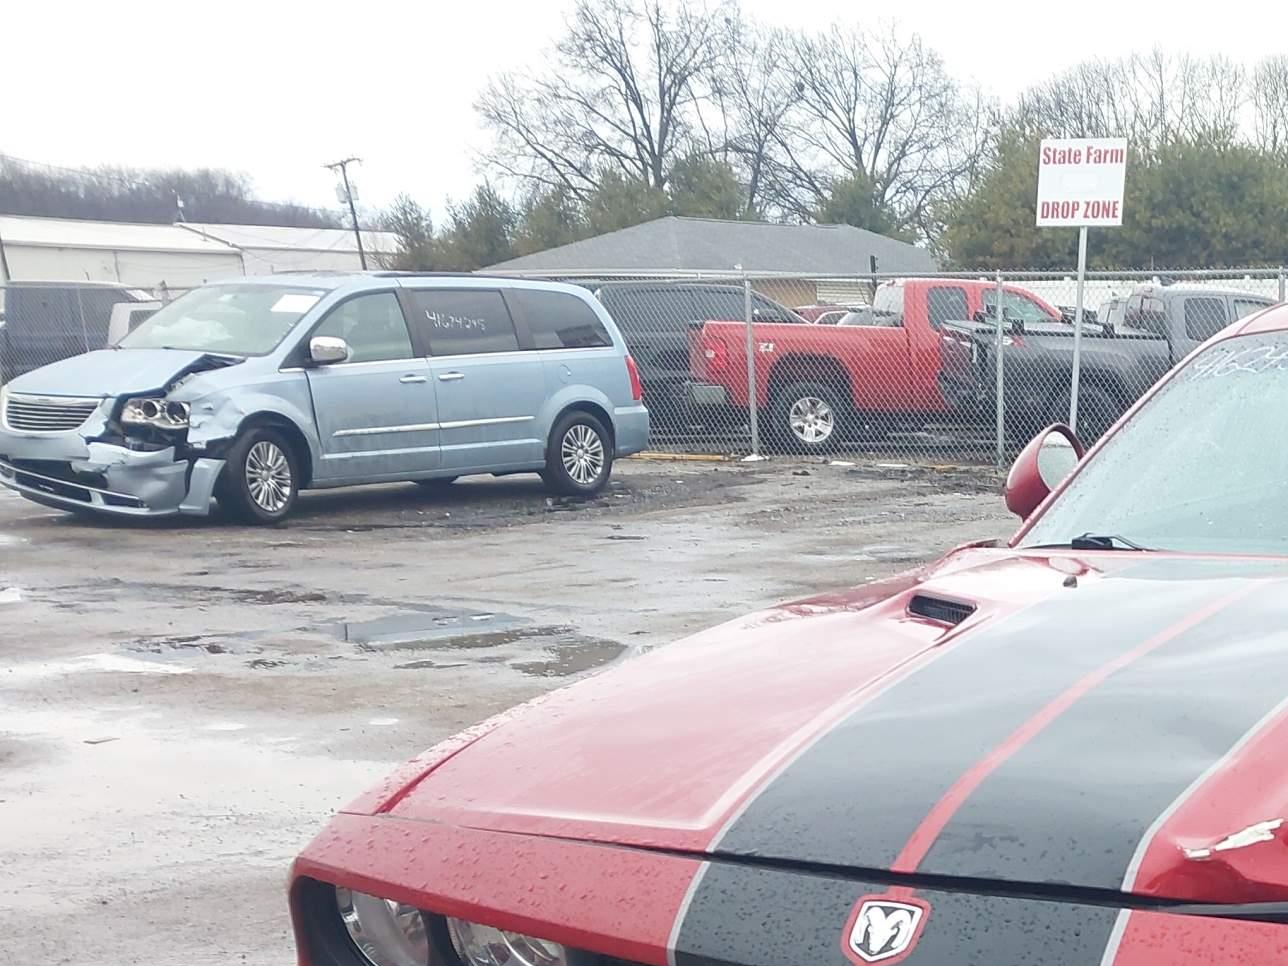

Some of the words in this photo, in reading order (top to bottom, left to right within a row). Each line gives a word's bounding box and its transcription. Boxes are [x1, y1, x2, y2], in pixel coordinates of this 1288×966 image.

[1042, 146, 1082, 165] State
[1085, 146, 1124, 164] Farm
[1040, 201, 1080, 219] DROP
[1082, 200, 1119, 219] ZONE
